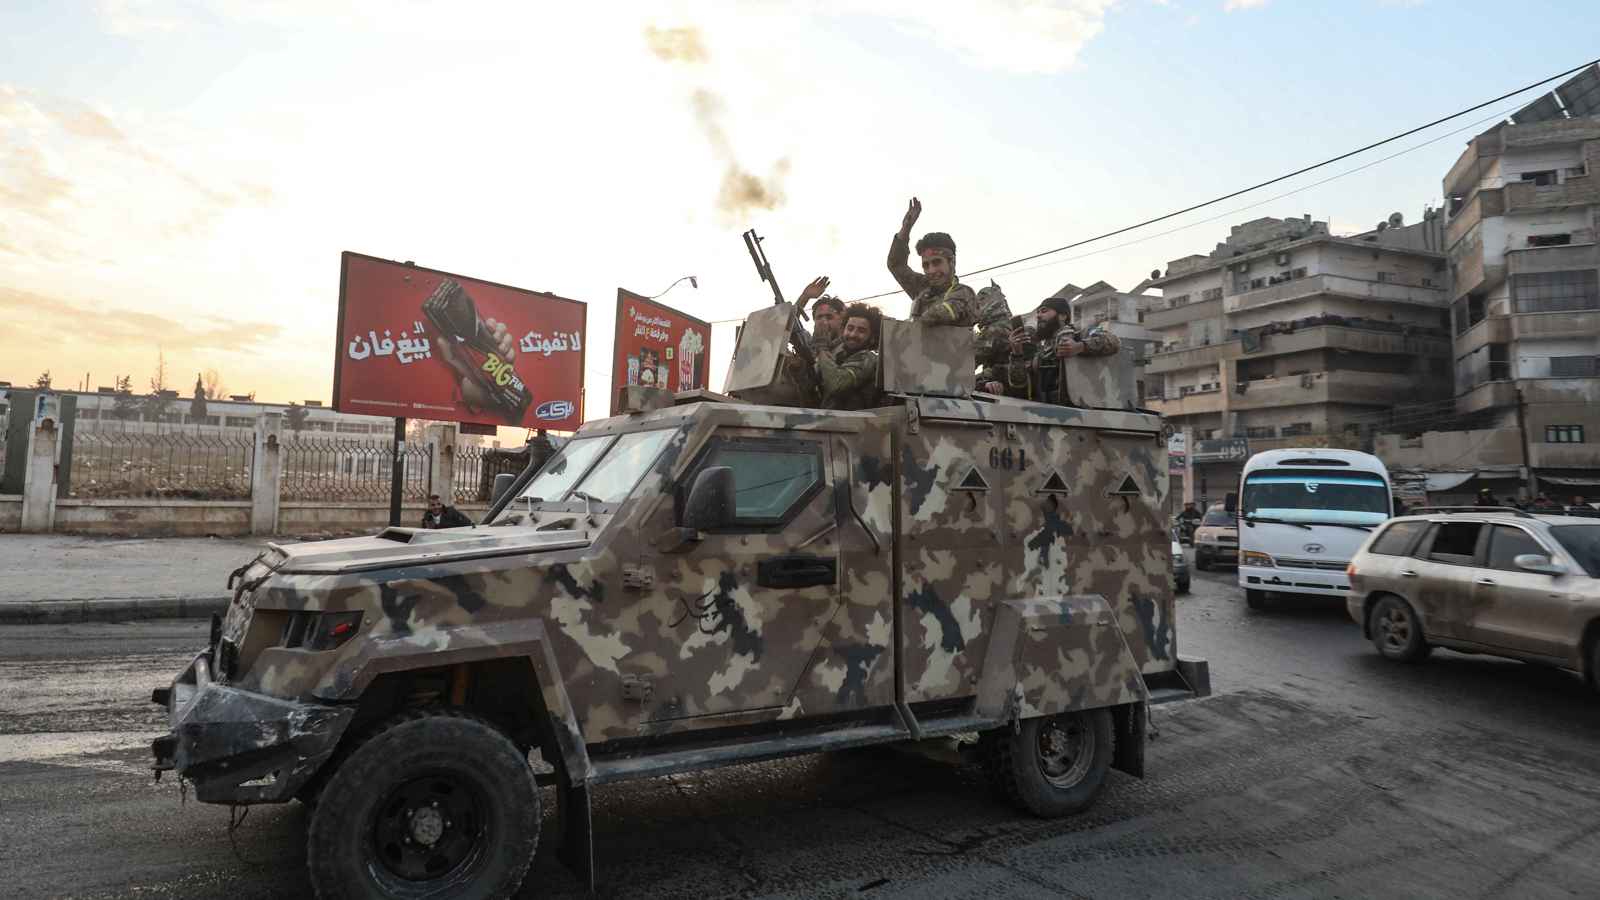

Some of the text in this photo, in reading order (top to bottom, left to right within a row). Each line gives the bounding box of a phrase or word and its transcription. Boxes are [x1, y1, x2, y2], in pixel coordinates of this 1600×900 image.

[348, 329, 395, 360] فان
[519, 330, 581, 357] لا تفوتك
[482, 352, 514, 386] BIG
